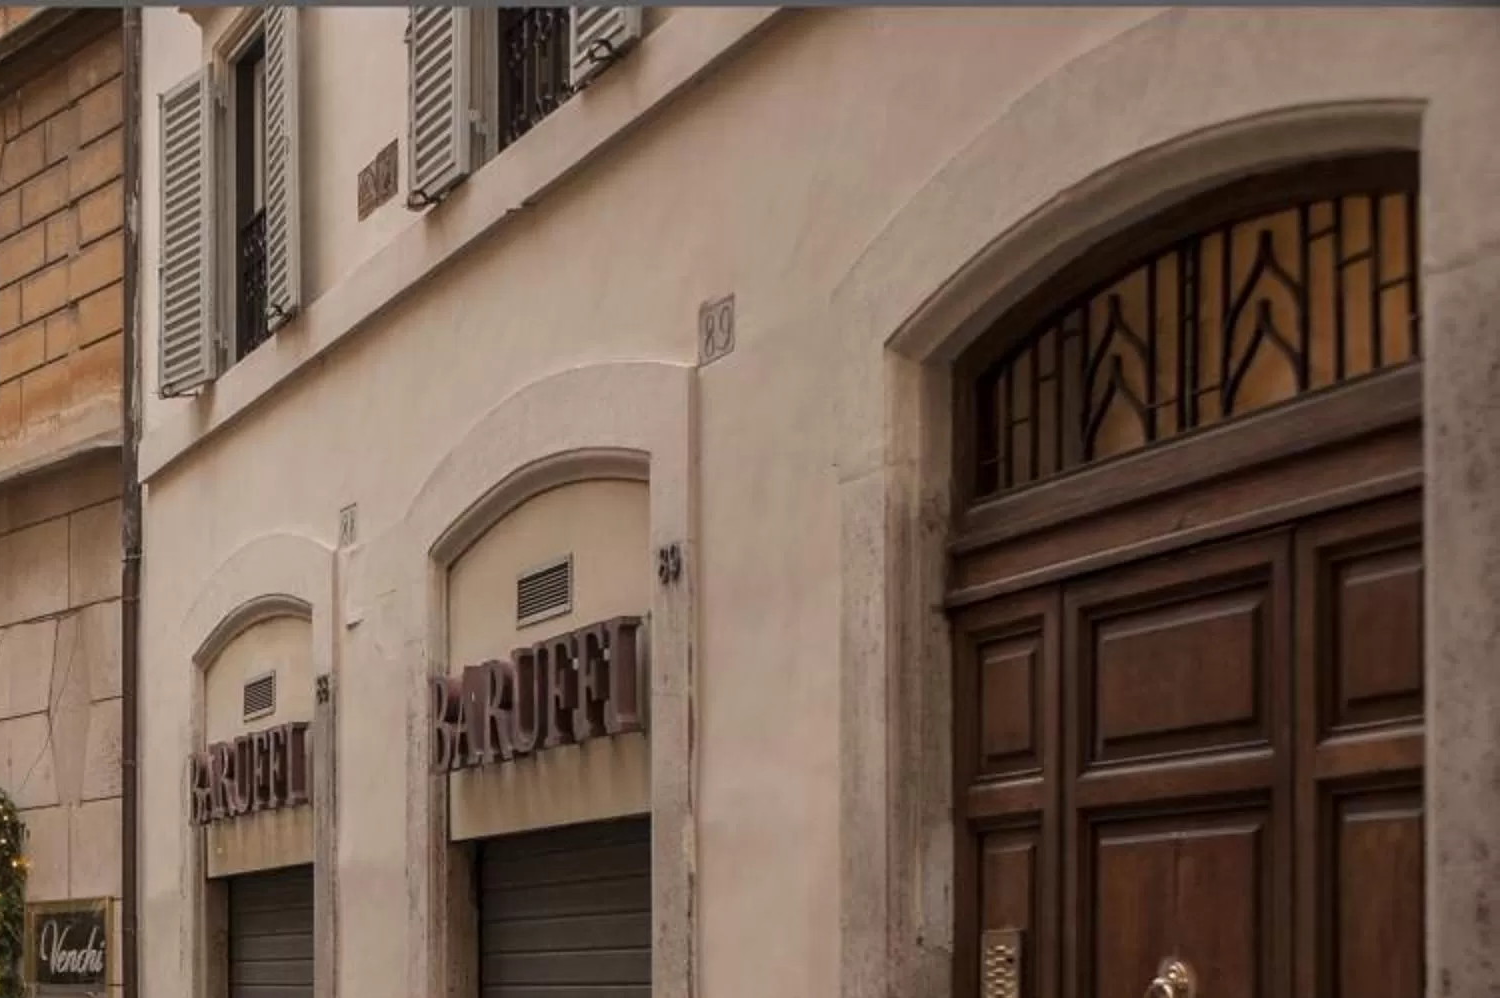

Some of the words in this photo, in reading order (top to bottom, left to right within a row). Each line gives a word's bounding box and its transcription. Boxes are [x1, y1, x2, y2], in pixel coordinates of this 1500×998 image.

[430, 616, 645, 773] BARUFFI
[189, 722, 309, 825] BARUFFI
[41, 919, 105, 974] Venchi
